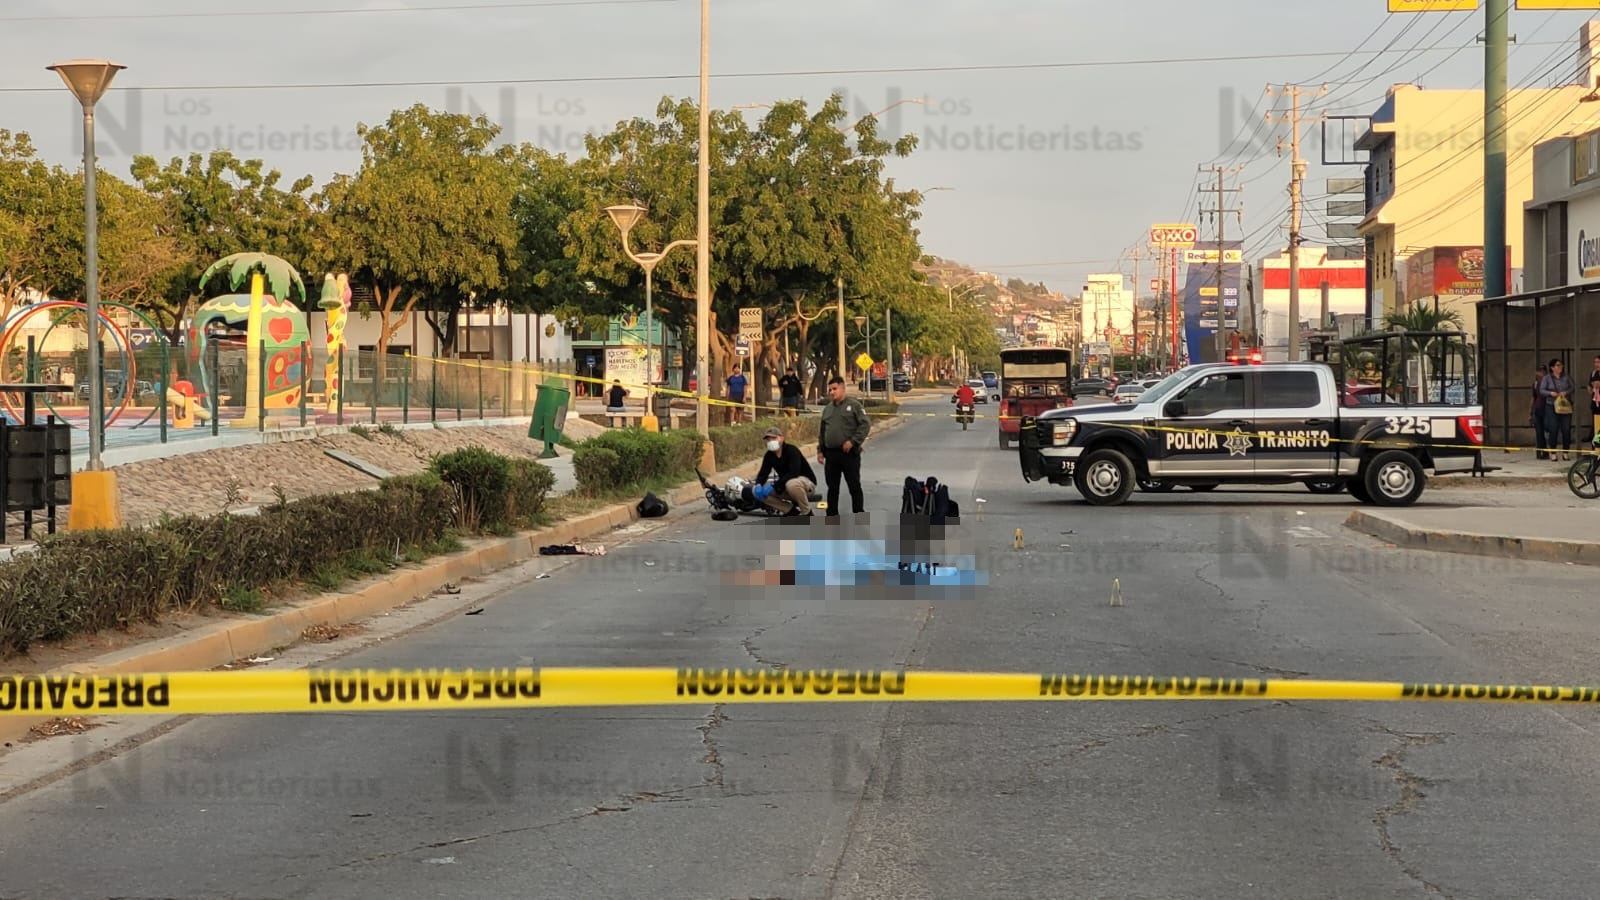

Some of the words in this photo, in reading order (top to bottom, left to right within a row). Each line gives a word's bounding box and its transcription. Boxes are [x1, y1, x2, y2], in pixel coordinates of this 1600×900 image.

[1153, 229, 1195, 242] OXXO
[1385, 416, 1430, 434] 325
[1257, 431, 1330, 448] TRANSITO
